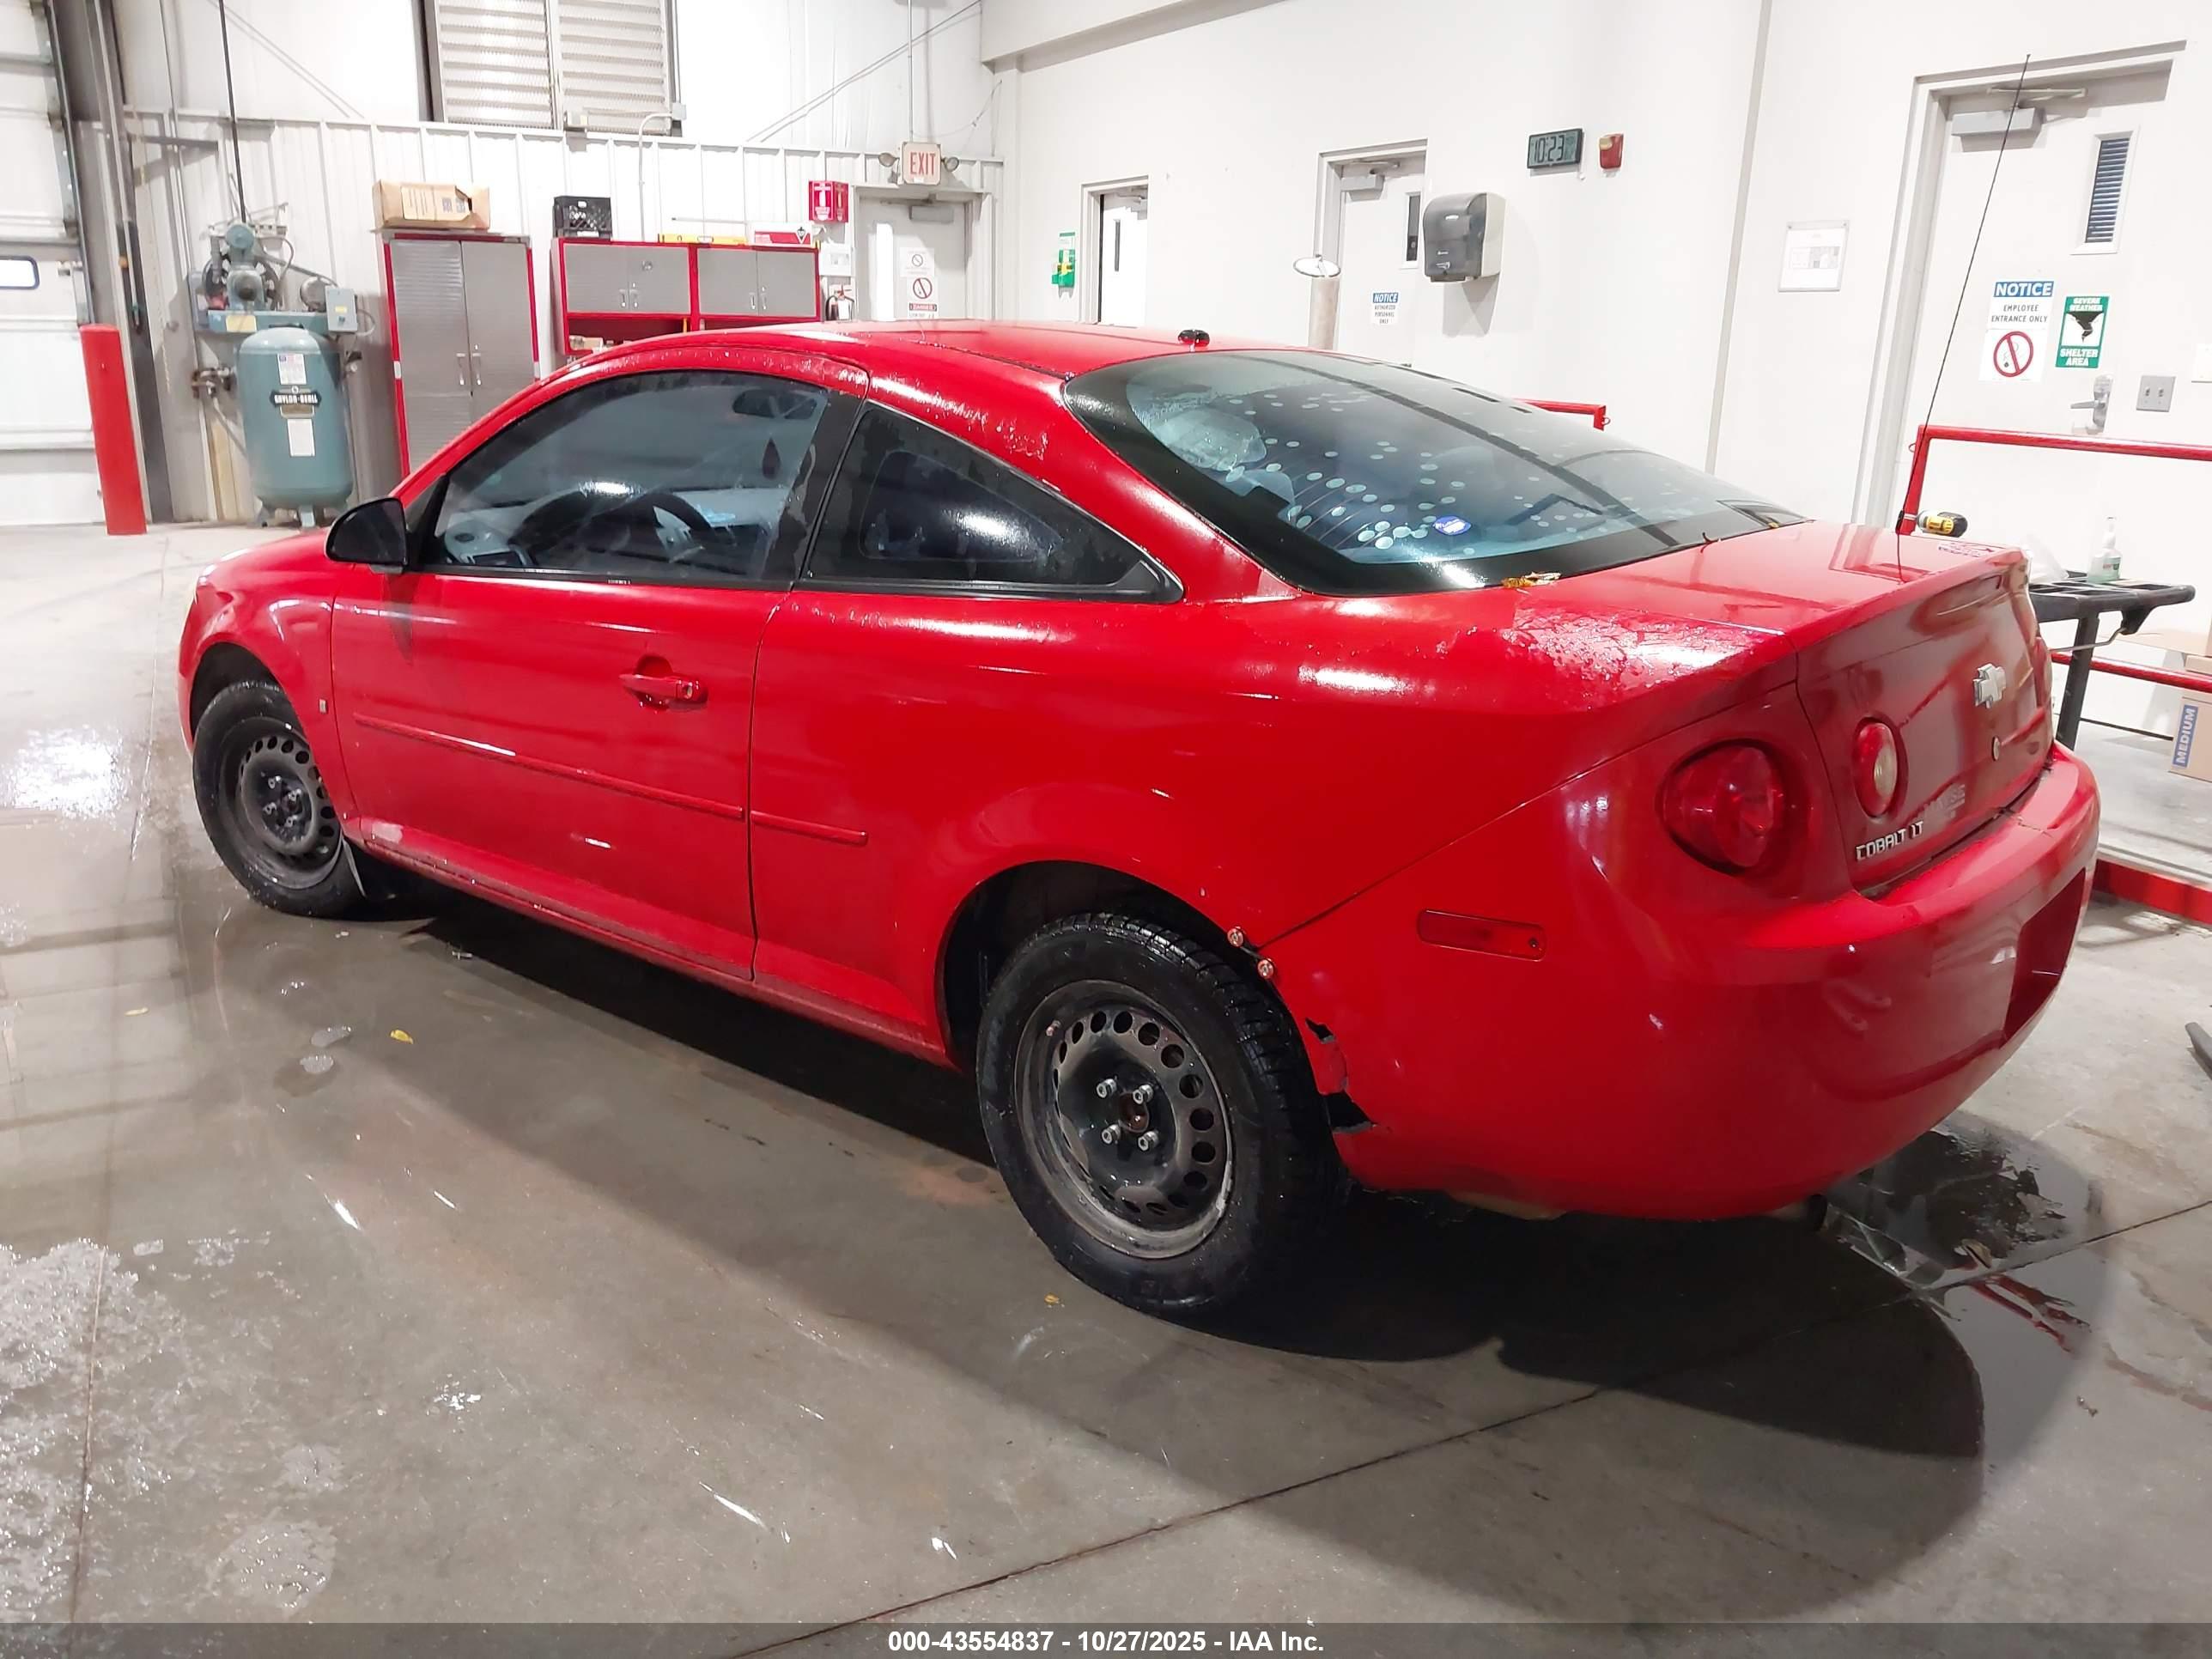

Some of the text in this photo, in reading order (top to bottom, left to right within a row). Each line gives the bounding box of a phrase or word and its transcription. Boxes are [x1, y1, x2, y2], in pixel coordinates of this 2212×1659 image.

[909, 151, 936, 176] EXIT
[1996, 283, 2053, 296] NOTICE
[1374, 293, 1398, 303] NOTICE
[2060, 349, 2099, 357] SHELTER
[2066, 357, 2089, 366] AREA
[2175, 708, 2197, 764] MEDIUM
[1856, 821, 1924, 861] COBALT LT
